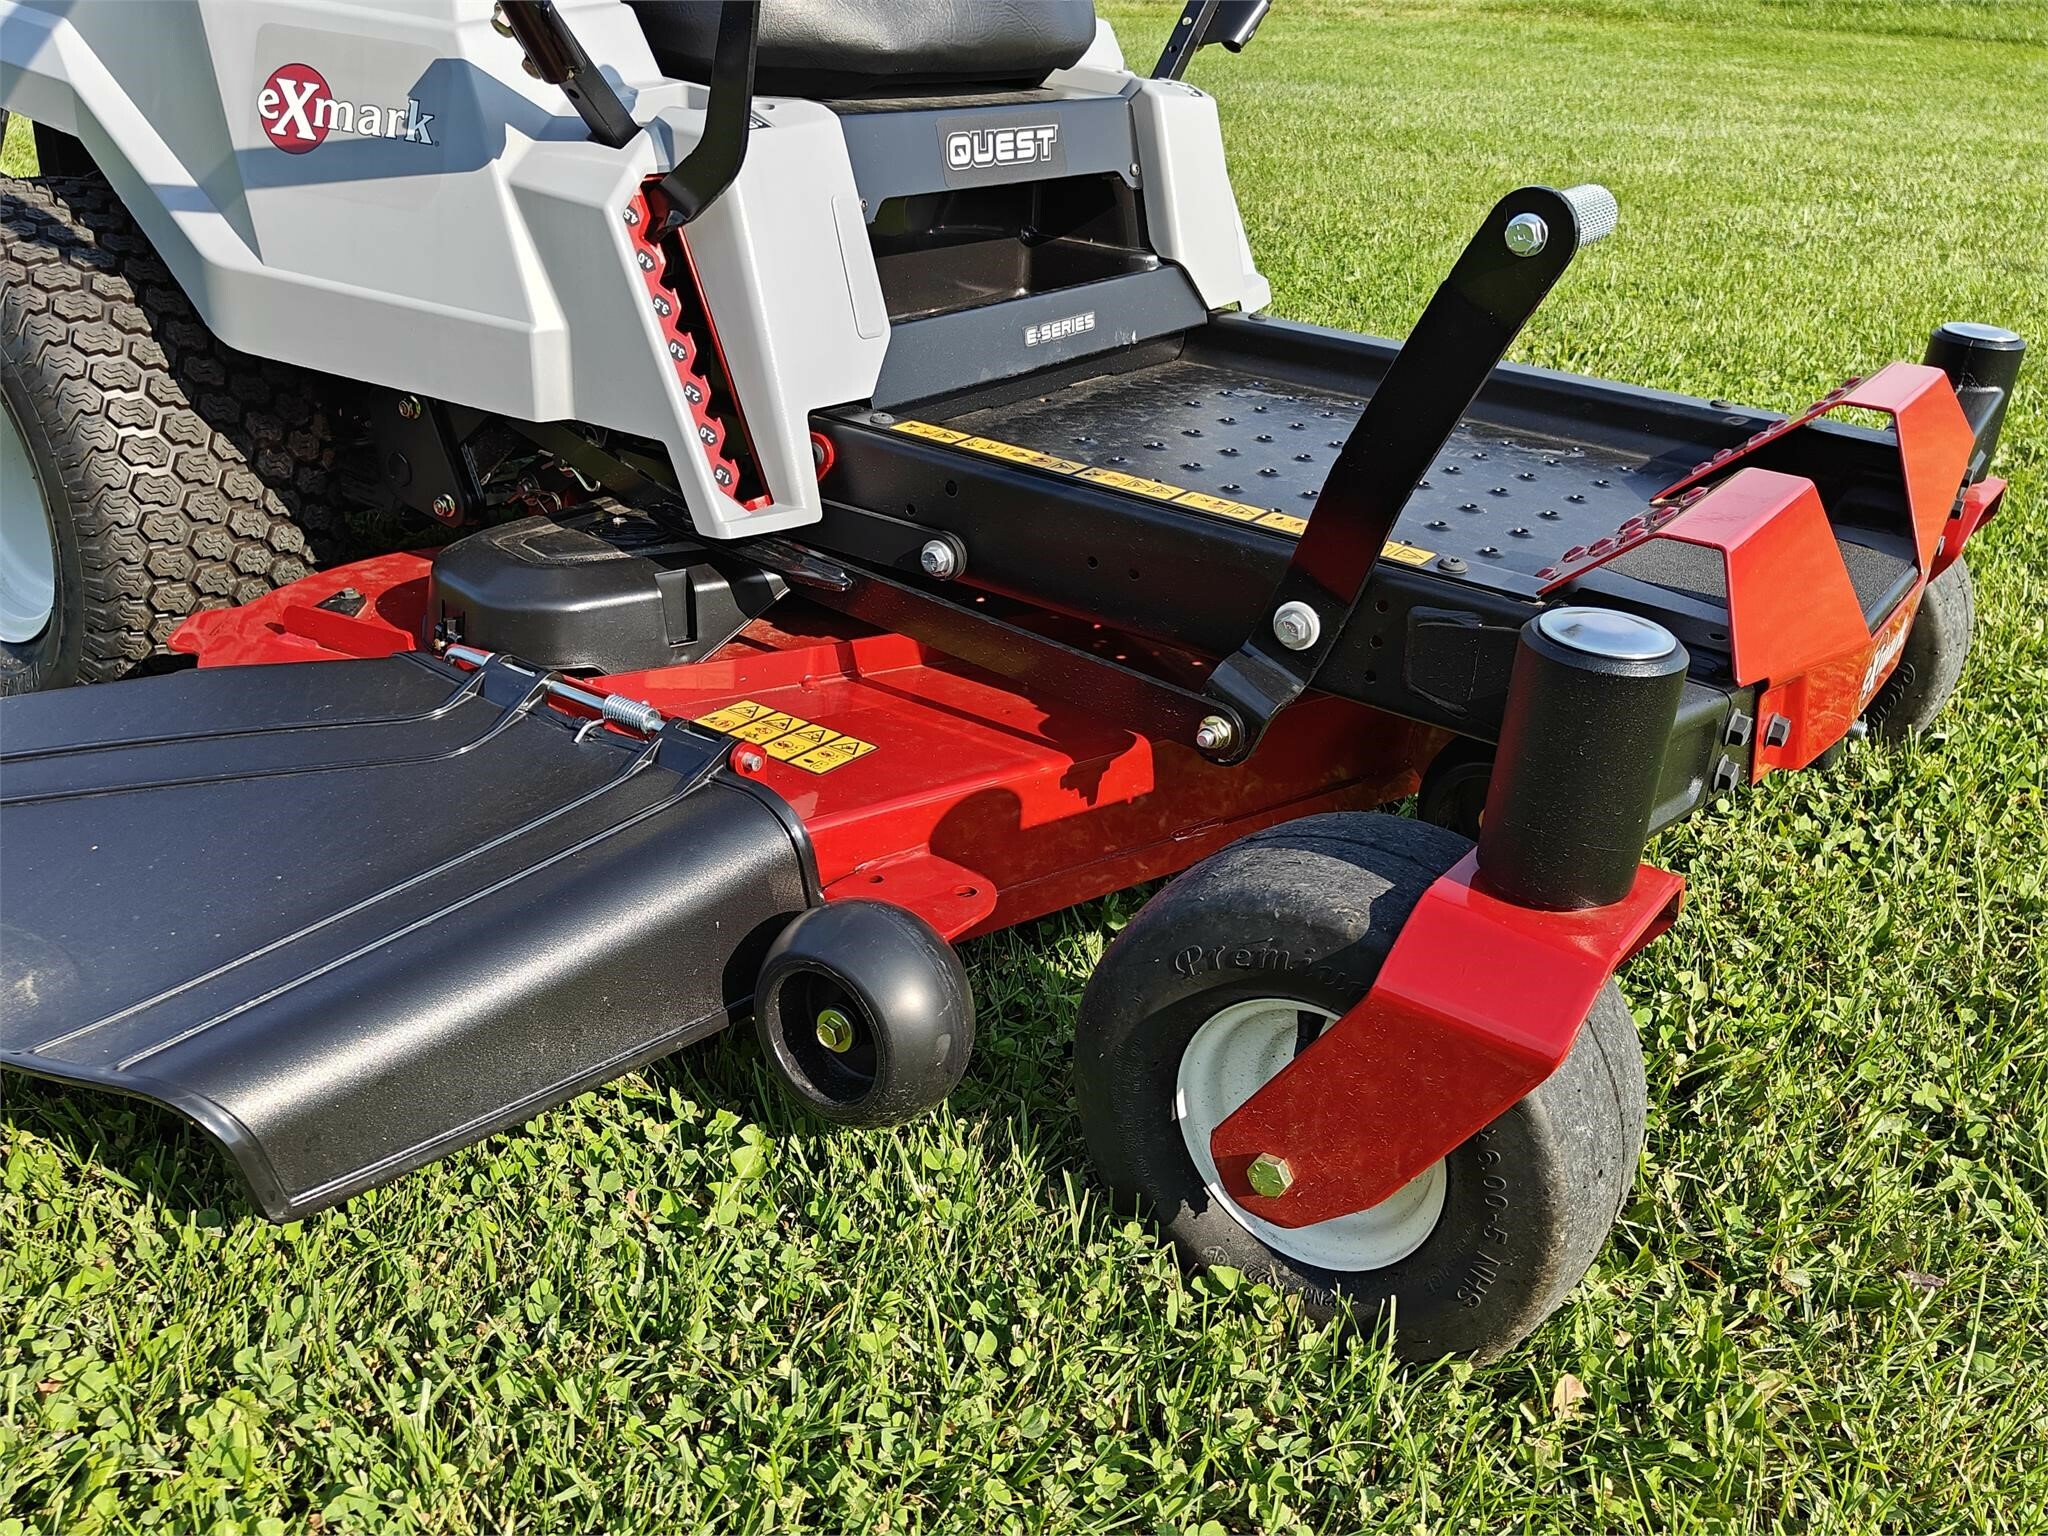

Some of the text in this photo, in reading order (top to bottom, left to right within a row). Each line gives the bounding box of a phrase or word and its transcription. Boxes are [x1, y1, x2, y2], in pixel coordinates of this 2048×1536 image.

[946, 124, 1058, 171] QUEST
[623, 208, 638, 224] 4.5
[638, 252, 653, 269] 4.0
[653, 298, 669, 314] 3.5
[1025, 312, 1095, 347] E-SERIES
[670, 342, 686, 359] 3.0
[684, 385, 701, 402] 2.5
[700, 427, 716, 444] 2.0
[715, 469, 731, 485] 1.5
[1456, 1252, 1503, 1309] NHS
